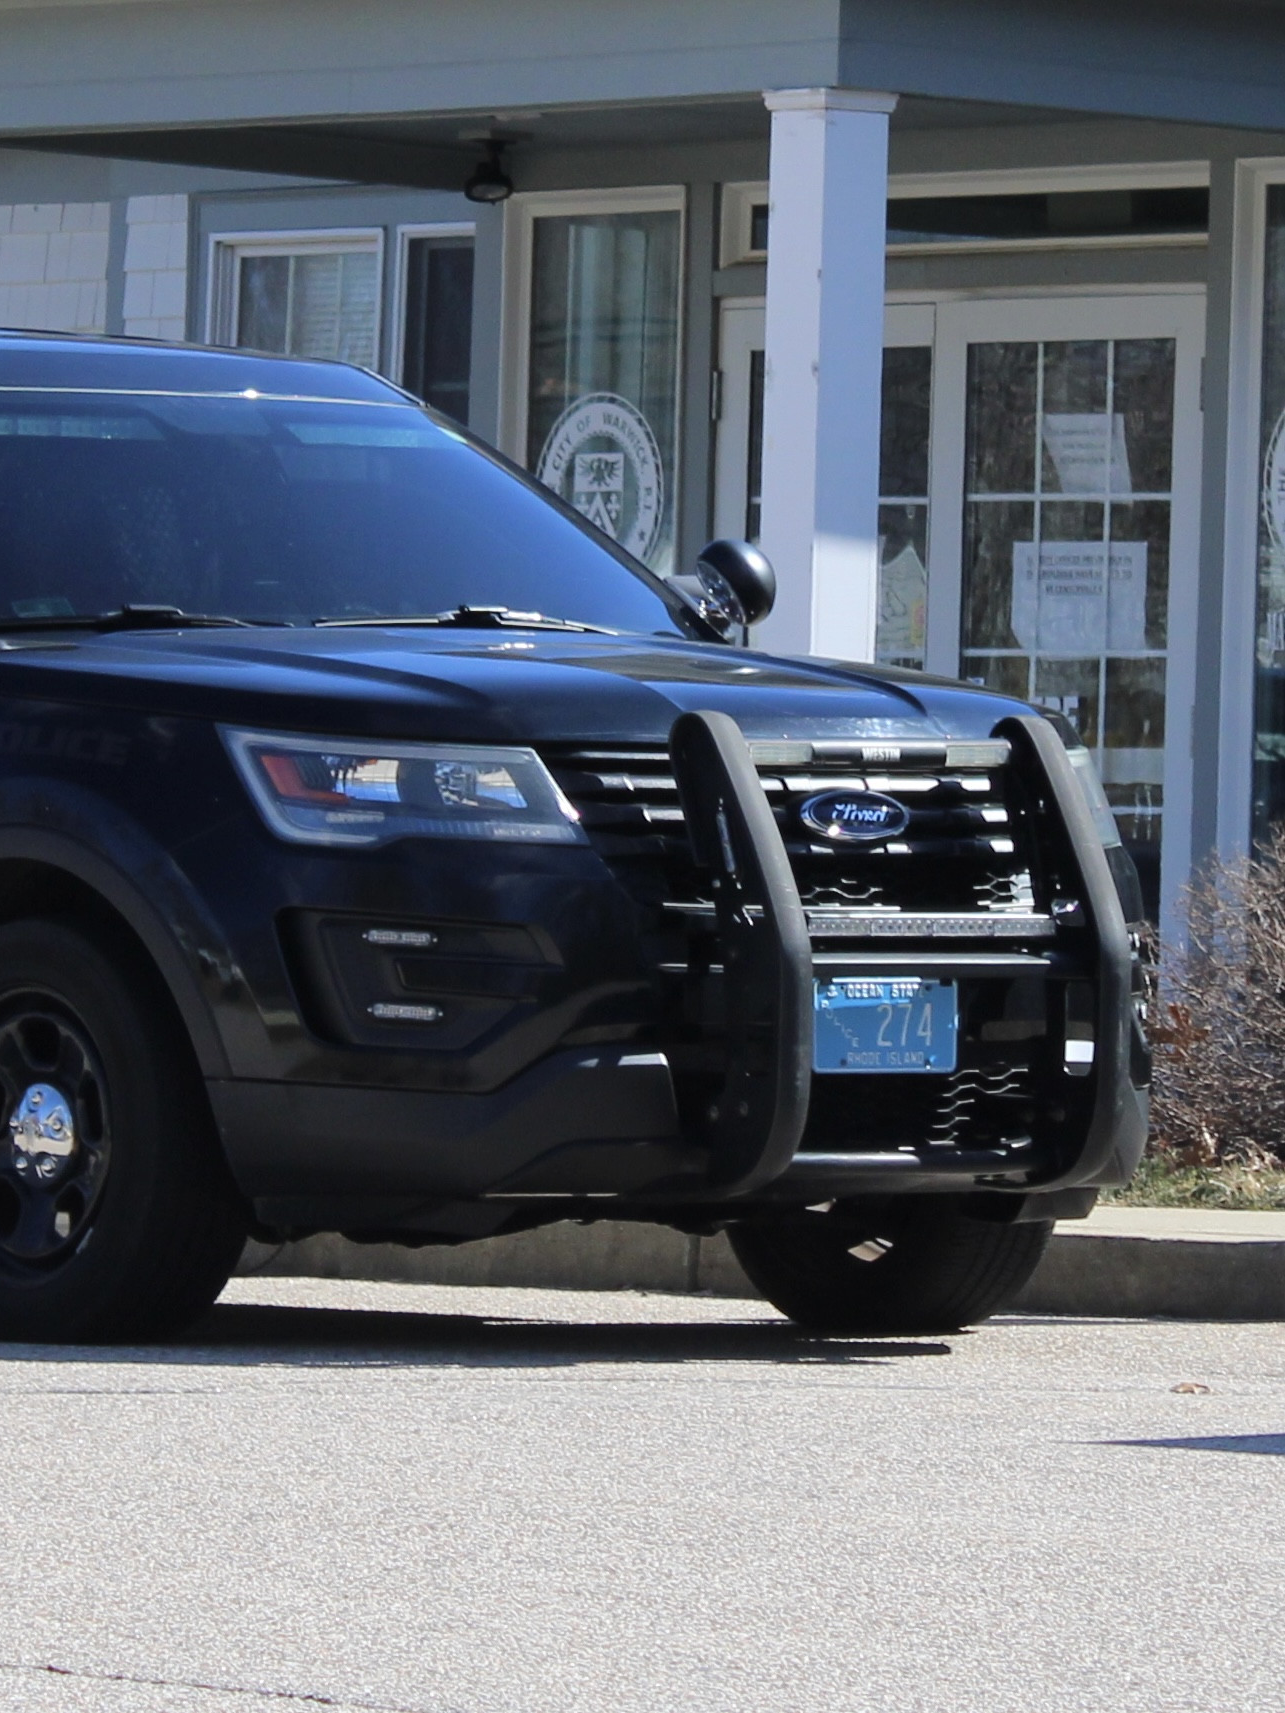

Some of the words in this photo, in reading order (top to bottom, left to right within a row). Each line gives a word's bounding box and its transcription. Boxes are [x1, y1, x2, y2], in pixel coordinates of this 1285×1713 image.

[552, 431, 573, 471] CITY
[577, 414, 592, 433] OF
[831, 803, 890, 822] Ford
[847, 983, 884, 998] OCEAN
[821, 999, 860, 1048] POLICE
[876, 1003, 933, 1047] 274
[847, 1052, 881, 1066] RHODE
[887, 1052, 925, 1066] ISLAND
